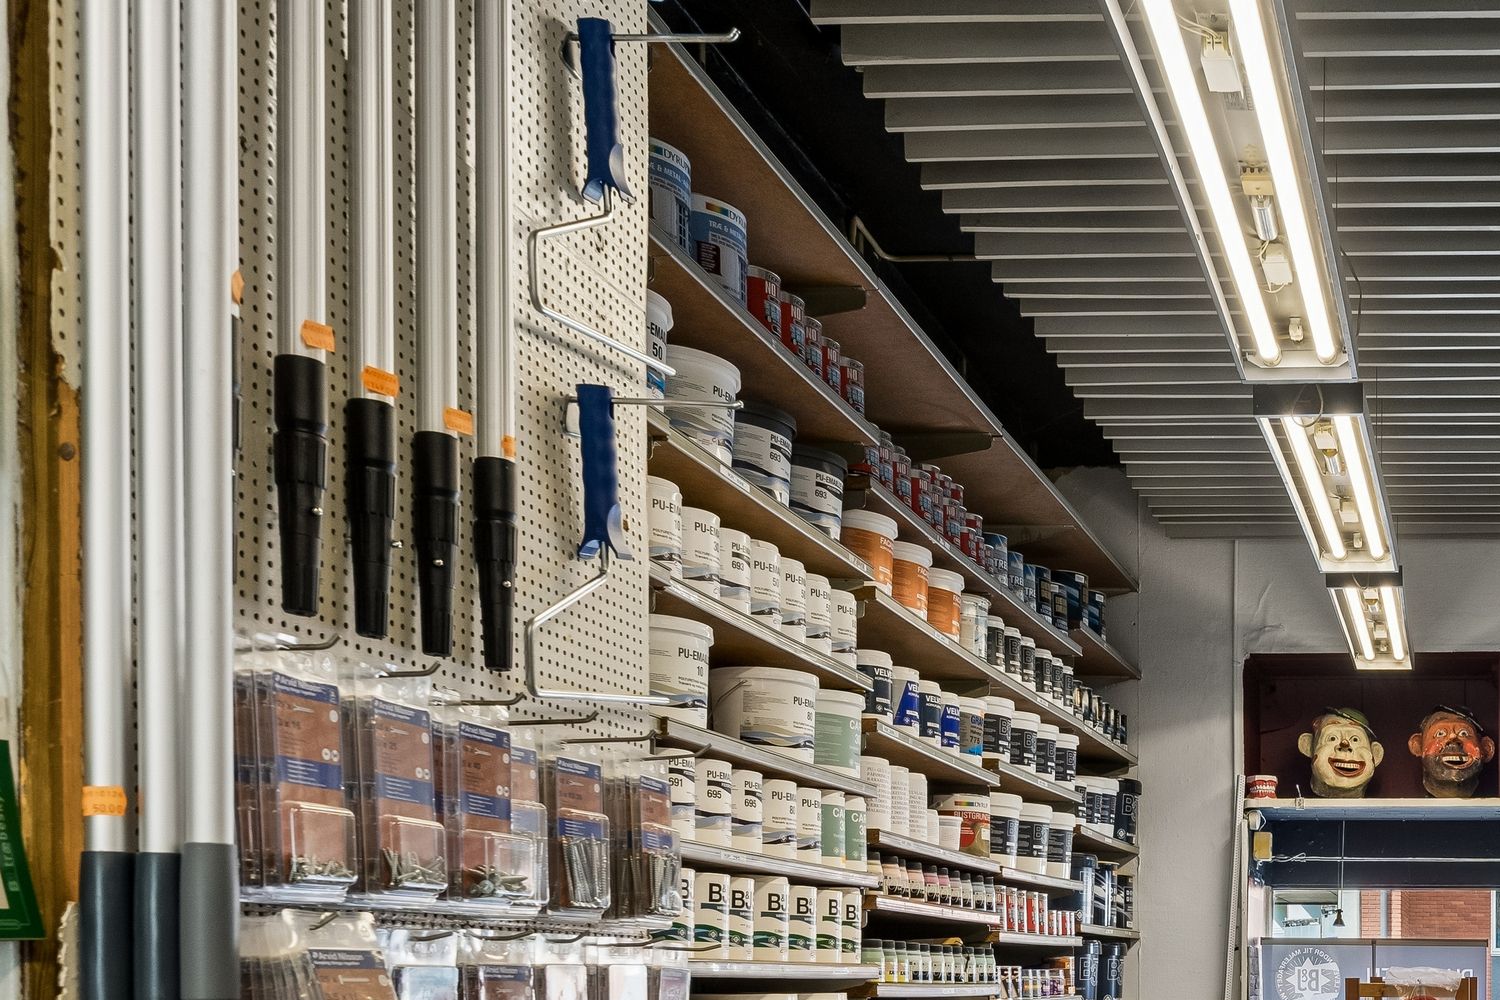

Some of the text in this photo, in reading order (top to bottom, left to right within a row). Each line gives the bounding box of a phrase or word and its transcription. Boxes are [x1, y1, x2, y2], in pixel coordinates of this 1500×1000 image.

[652, 342, 664, 360] 50
[769, 451, 781, 463] 693
[814, 488, 828, 500] 693
[731, 559, 745, 572] 693
[696, 666, 704, 677] 10
[706, 789, 722, 799] 695
[744, 798, 757, 808] 695
